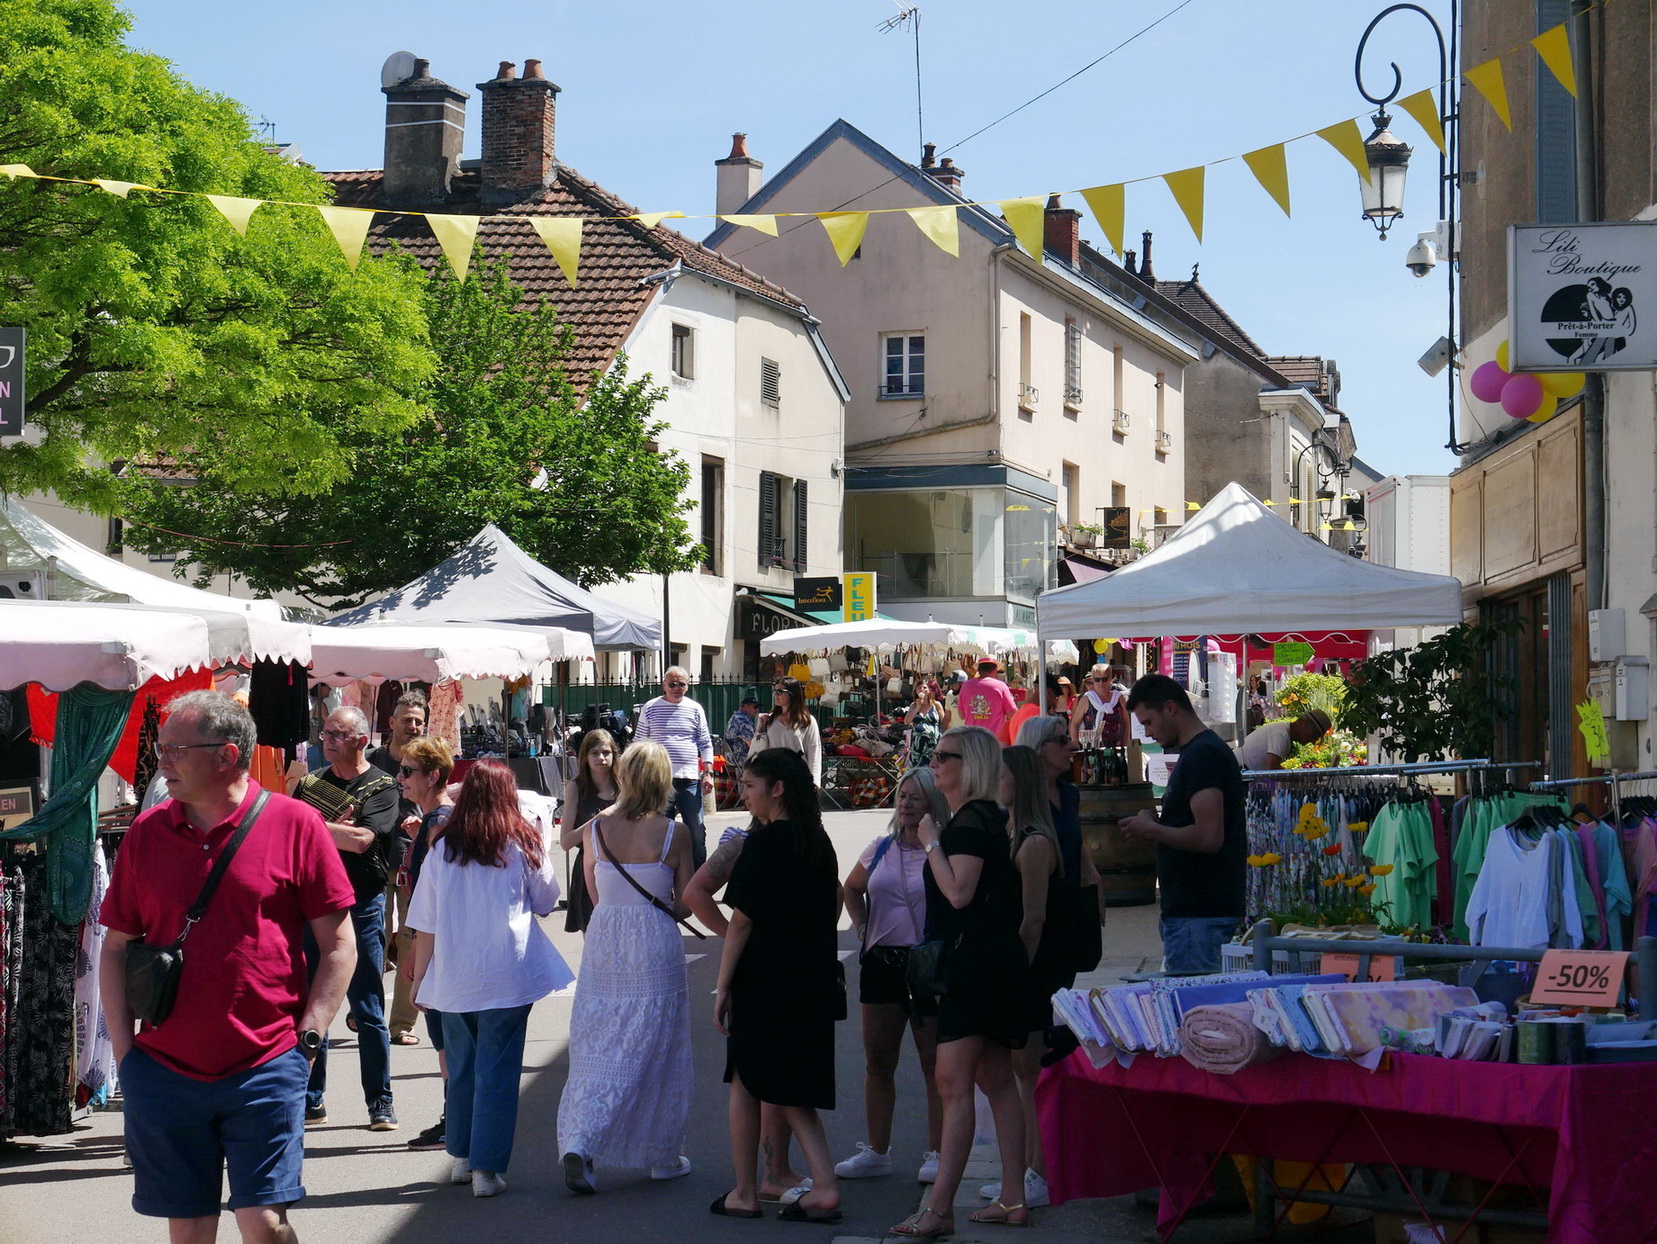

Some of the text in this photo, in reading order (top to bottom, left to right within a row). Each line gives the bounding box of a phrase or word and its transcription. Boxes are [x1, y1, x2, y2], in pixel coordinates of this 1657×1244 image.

[1532, 230, 1580, 254] Lili
[1547, 253, 1642, 281] Boutique
[1557, 322, 1615, 331] Prêt-à-Porter
[1180, 641, 1200, 650] MOIS
[1548, 965, 1610, 989] -50%
